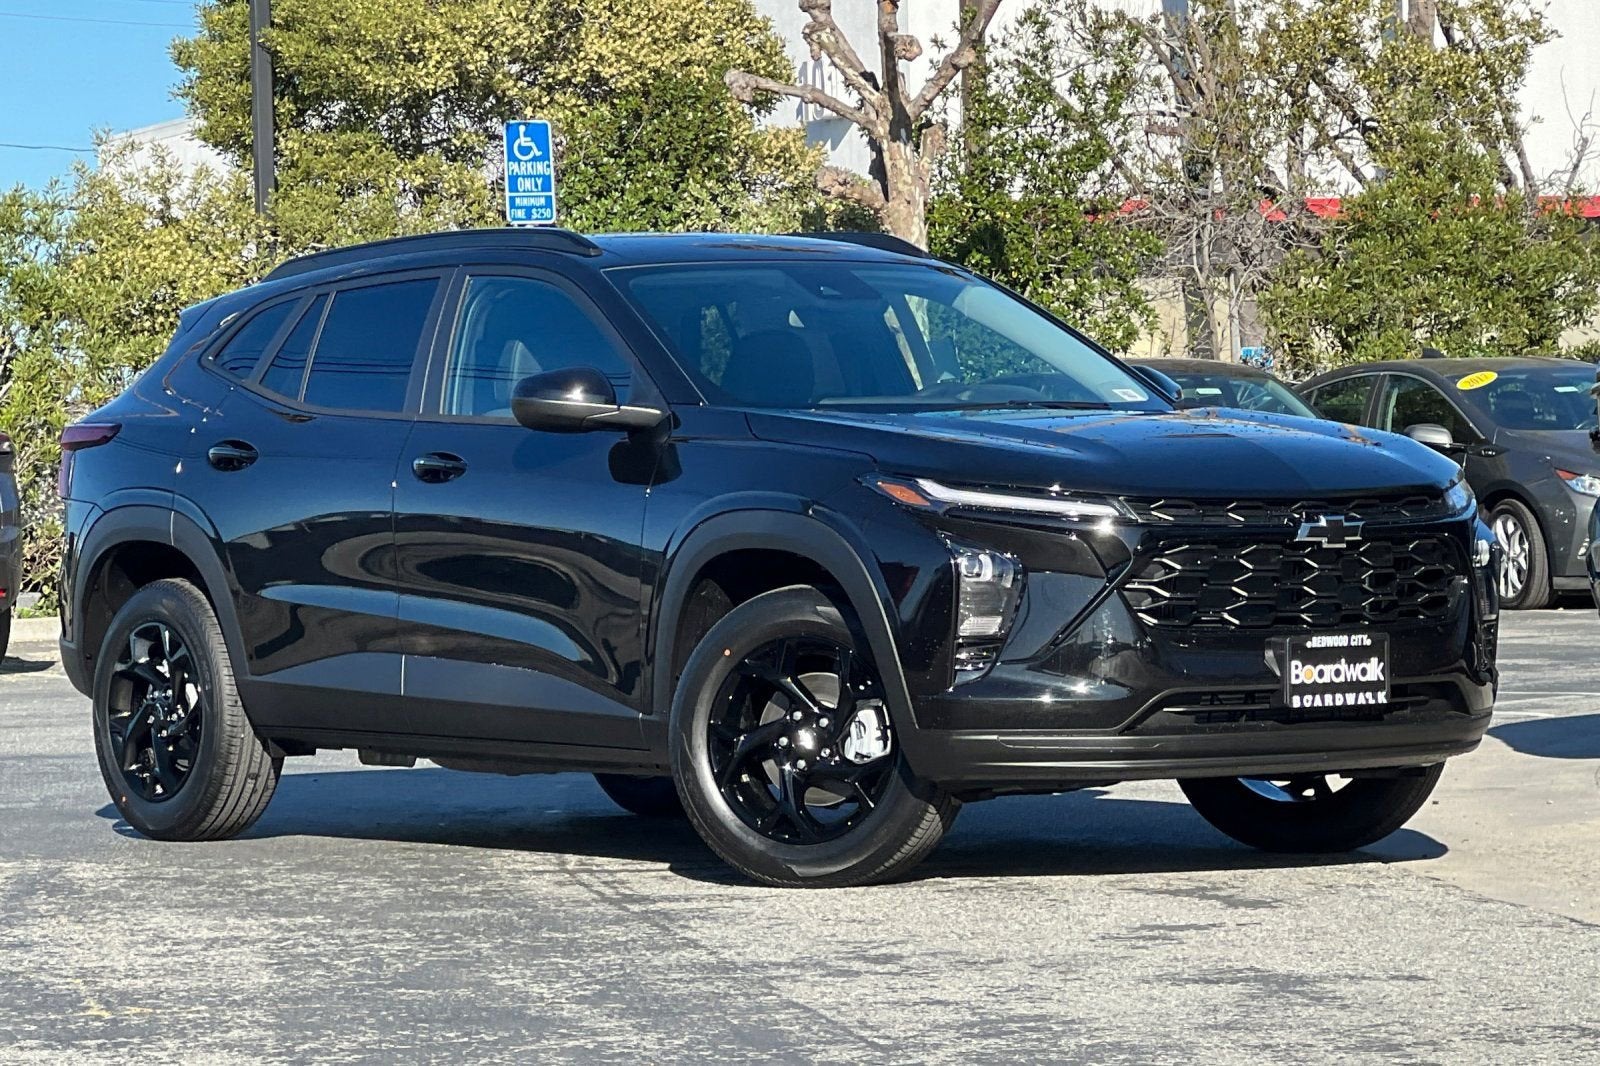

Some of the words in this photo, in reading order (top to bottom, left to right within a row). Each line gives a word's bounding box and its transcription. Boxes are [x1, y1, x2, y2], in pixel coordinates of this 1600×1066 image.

[508, 161, 551, 176] PARKING
[517, 177, 543, 192] ONLY
[515, 196, 546, 207] MINIMUM
[511, 208, 527, 219] FINE
[531, 207, 552, 220] $250
[1311, 635, 1349, 648] REDWOOD
[1350, 634, 1368, 647] CITY
[1290, 656, 1385, 685] Boardwalk
[1292, 691, 1388, 708] BOARDWALK
